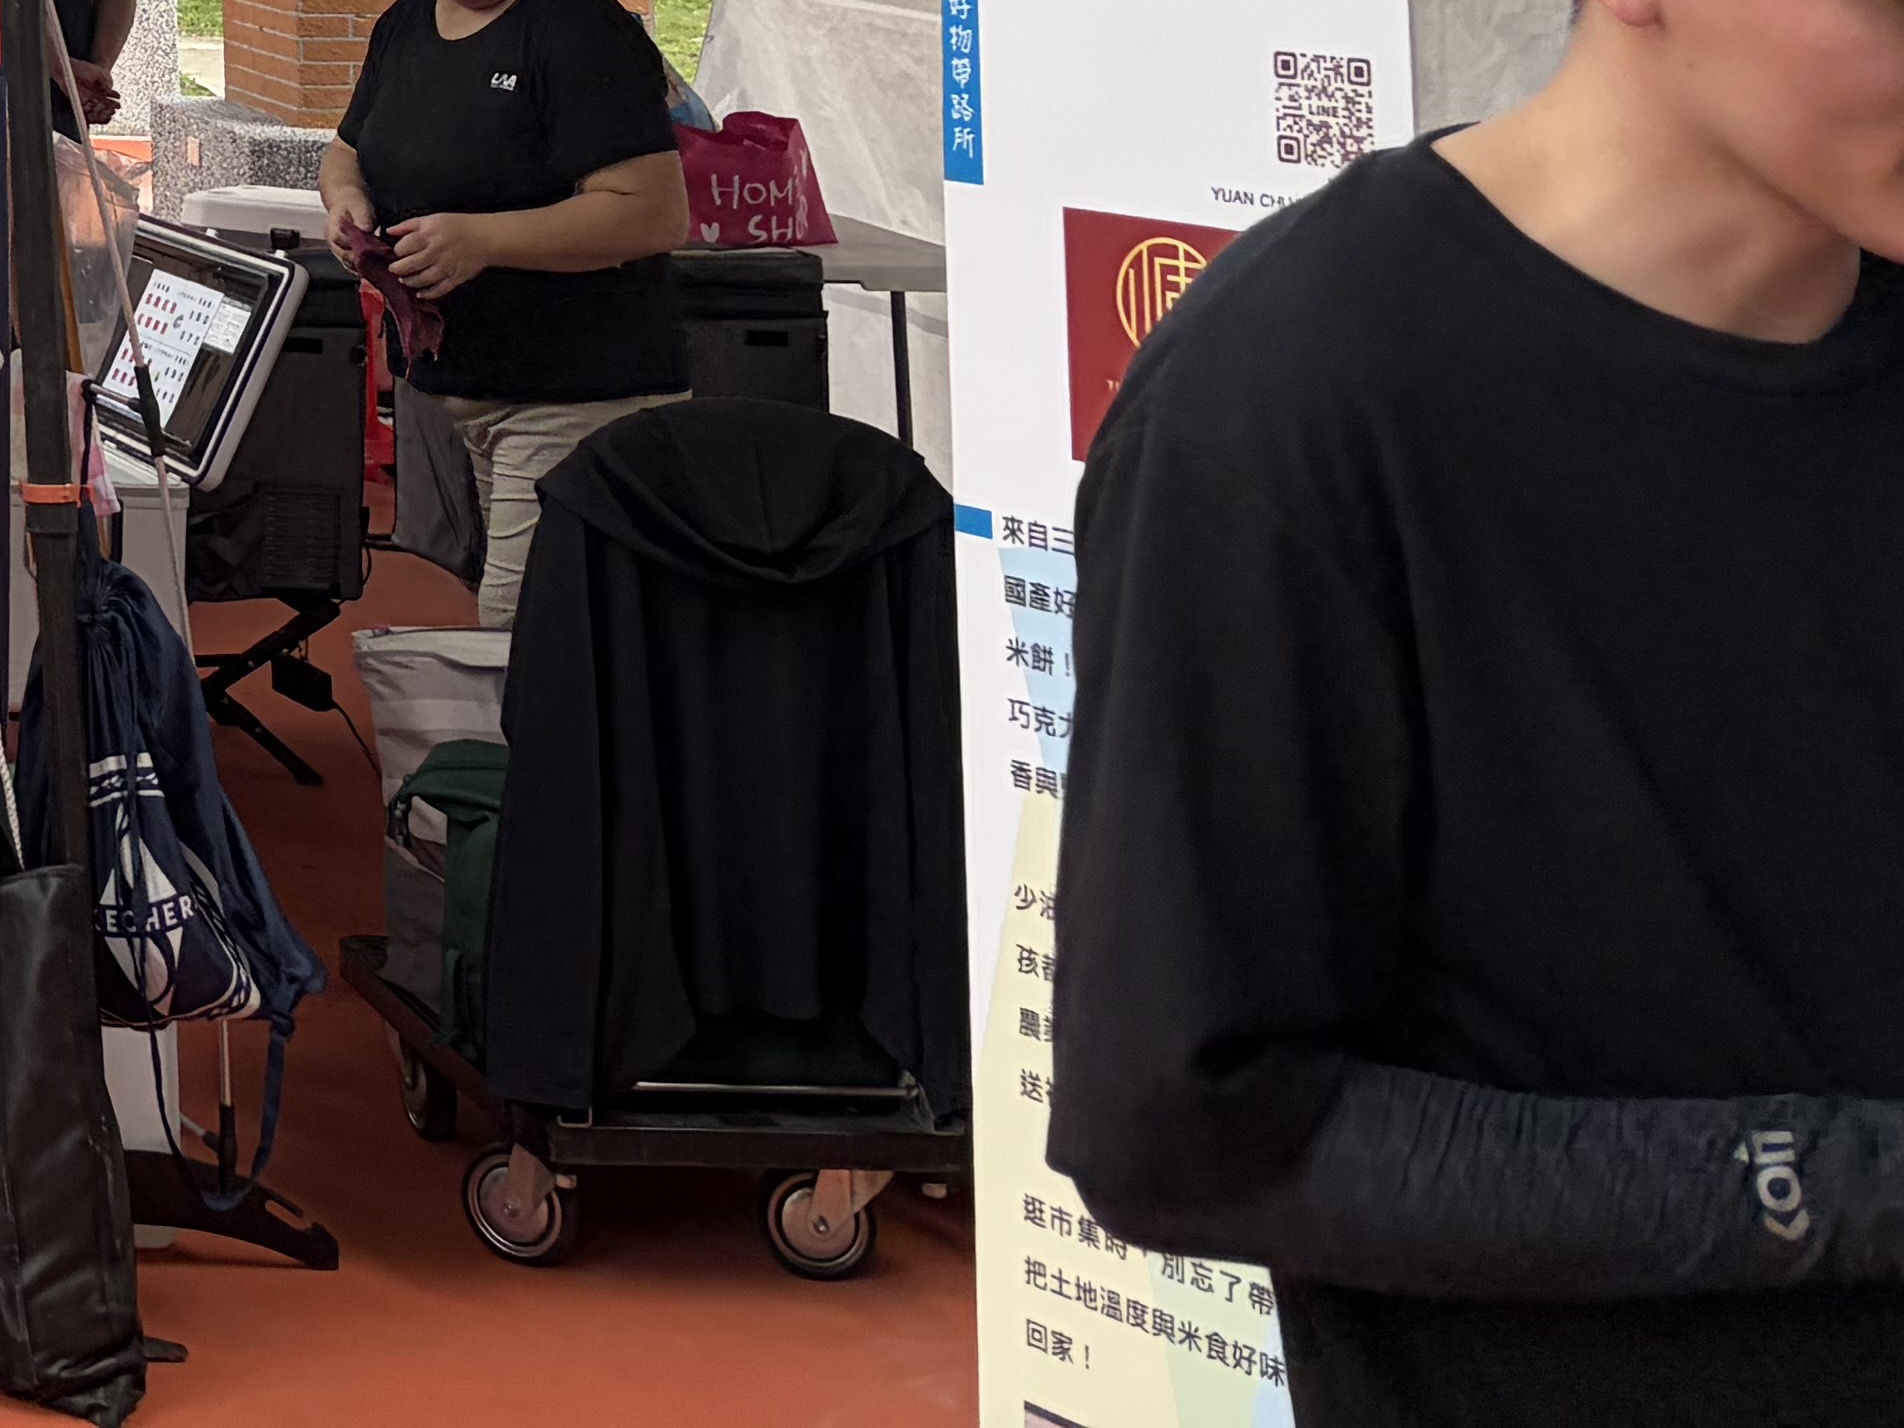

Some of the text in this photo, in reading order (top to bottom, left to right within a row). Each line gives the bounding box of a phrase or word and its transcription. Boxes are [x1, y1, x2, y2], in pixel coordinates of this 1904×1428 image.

[1308, 103, 1341, 119] LINE
[1211, 187, 1255, 206] YUAN
[1002, 516, 1075, 556] 來自三
[1009, 759, 1069, 799] 香與
[1024, 1256, 1286, 1387] 把土地溫度與米食好味
